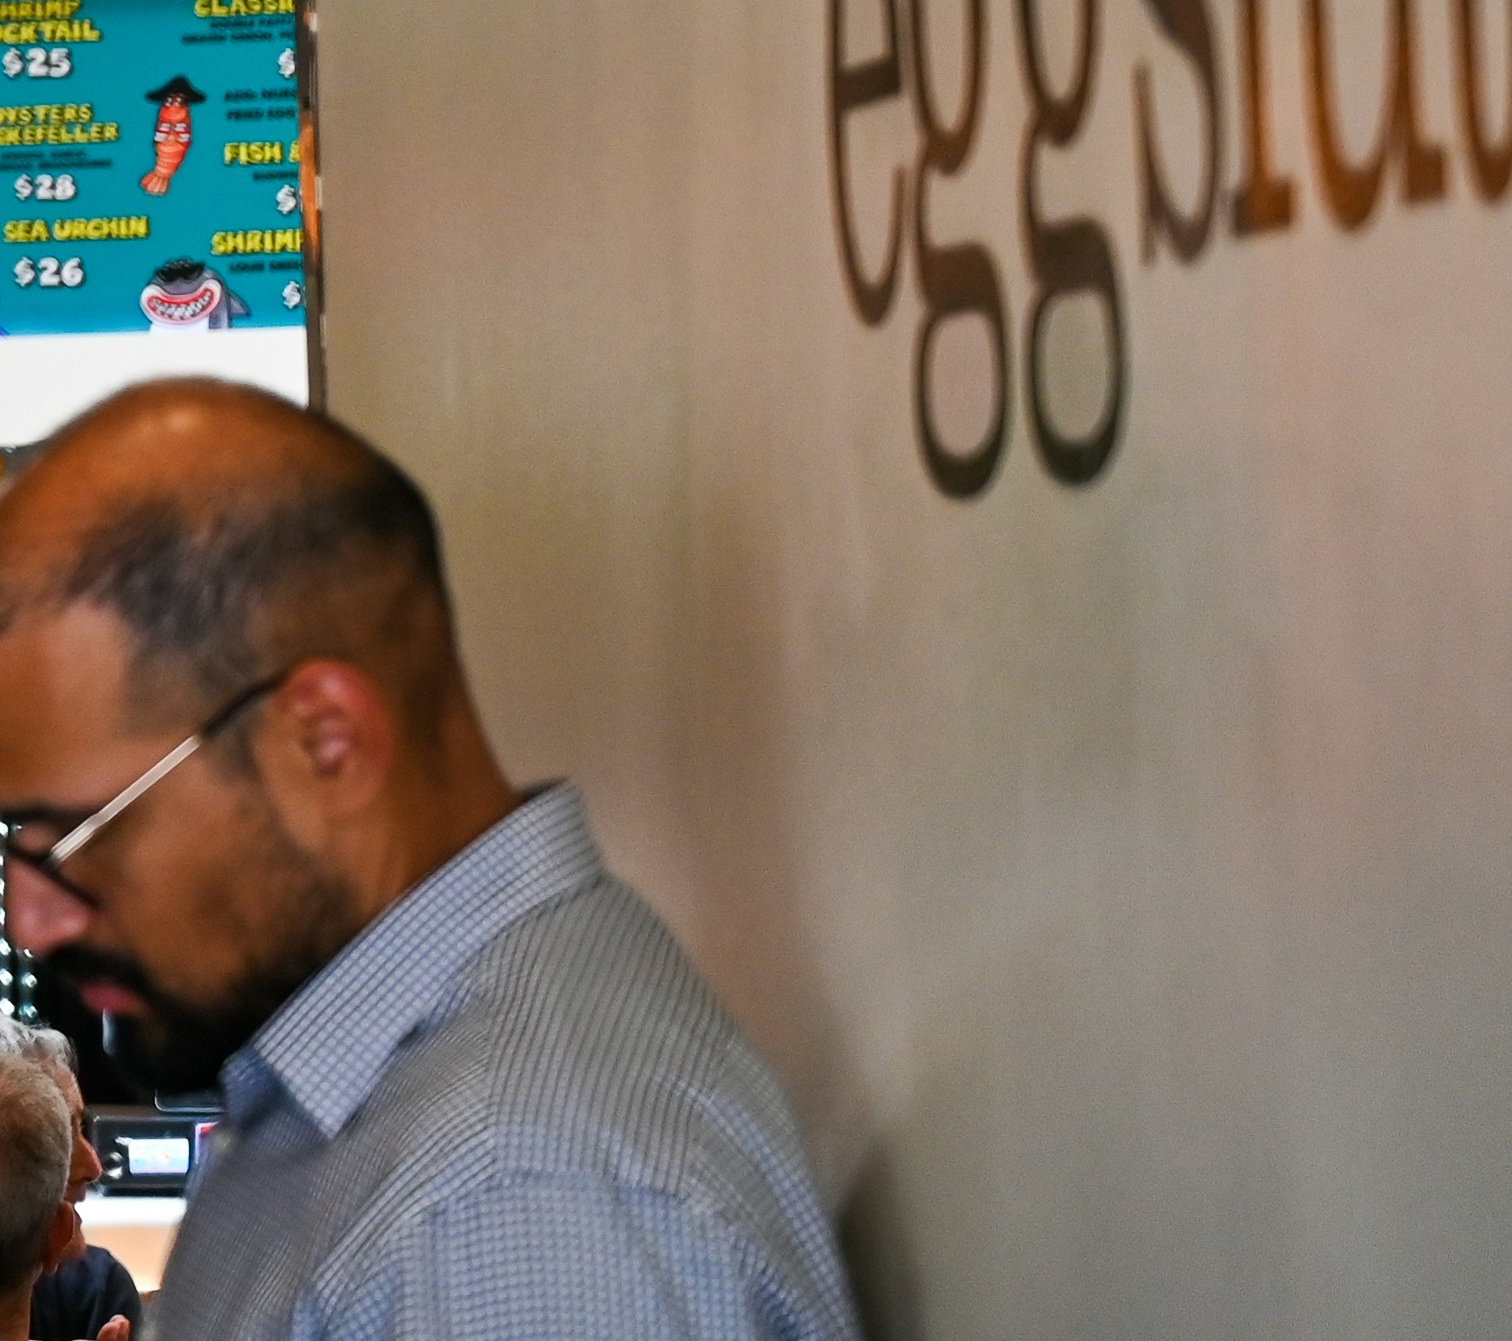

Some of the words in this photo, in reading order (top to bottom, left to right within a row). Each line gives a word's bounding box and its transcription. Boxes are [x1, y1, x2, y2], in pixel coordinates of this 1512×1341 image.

[2, 47, 72, 78] $25
[224, 142, 283, 165] FISH
[14, 173, 77, 201] $28
[3, 219, 50, 244] SEA
[51, 215, 150, 241] URCHIN
[14, 256, 84, 287] $26
